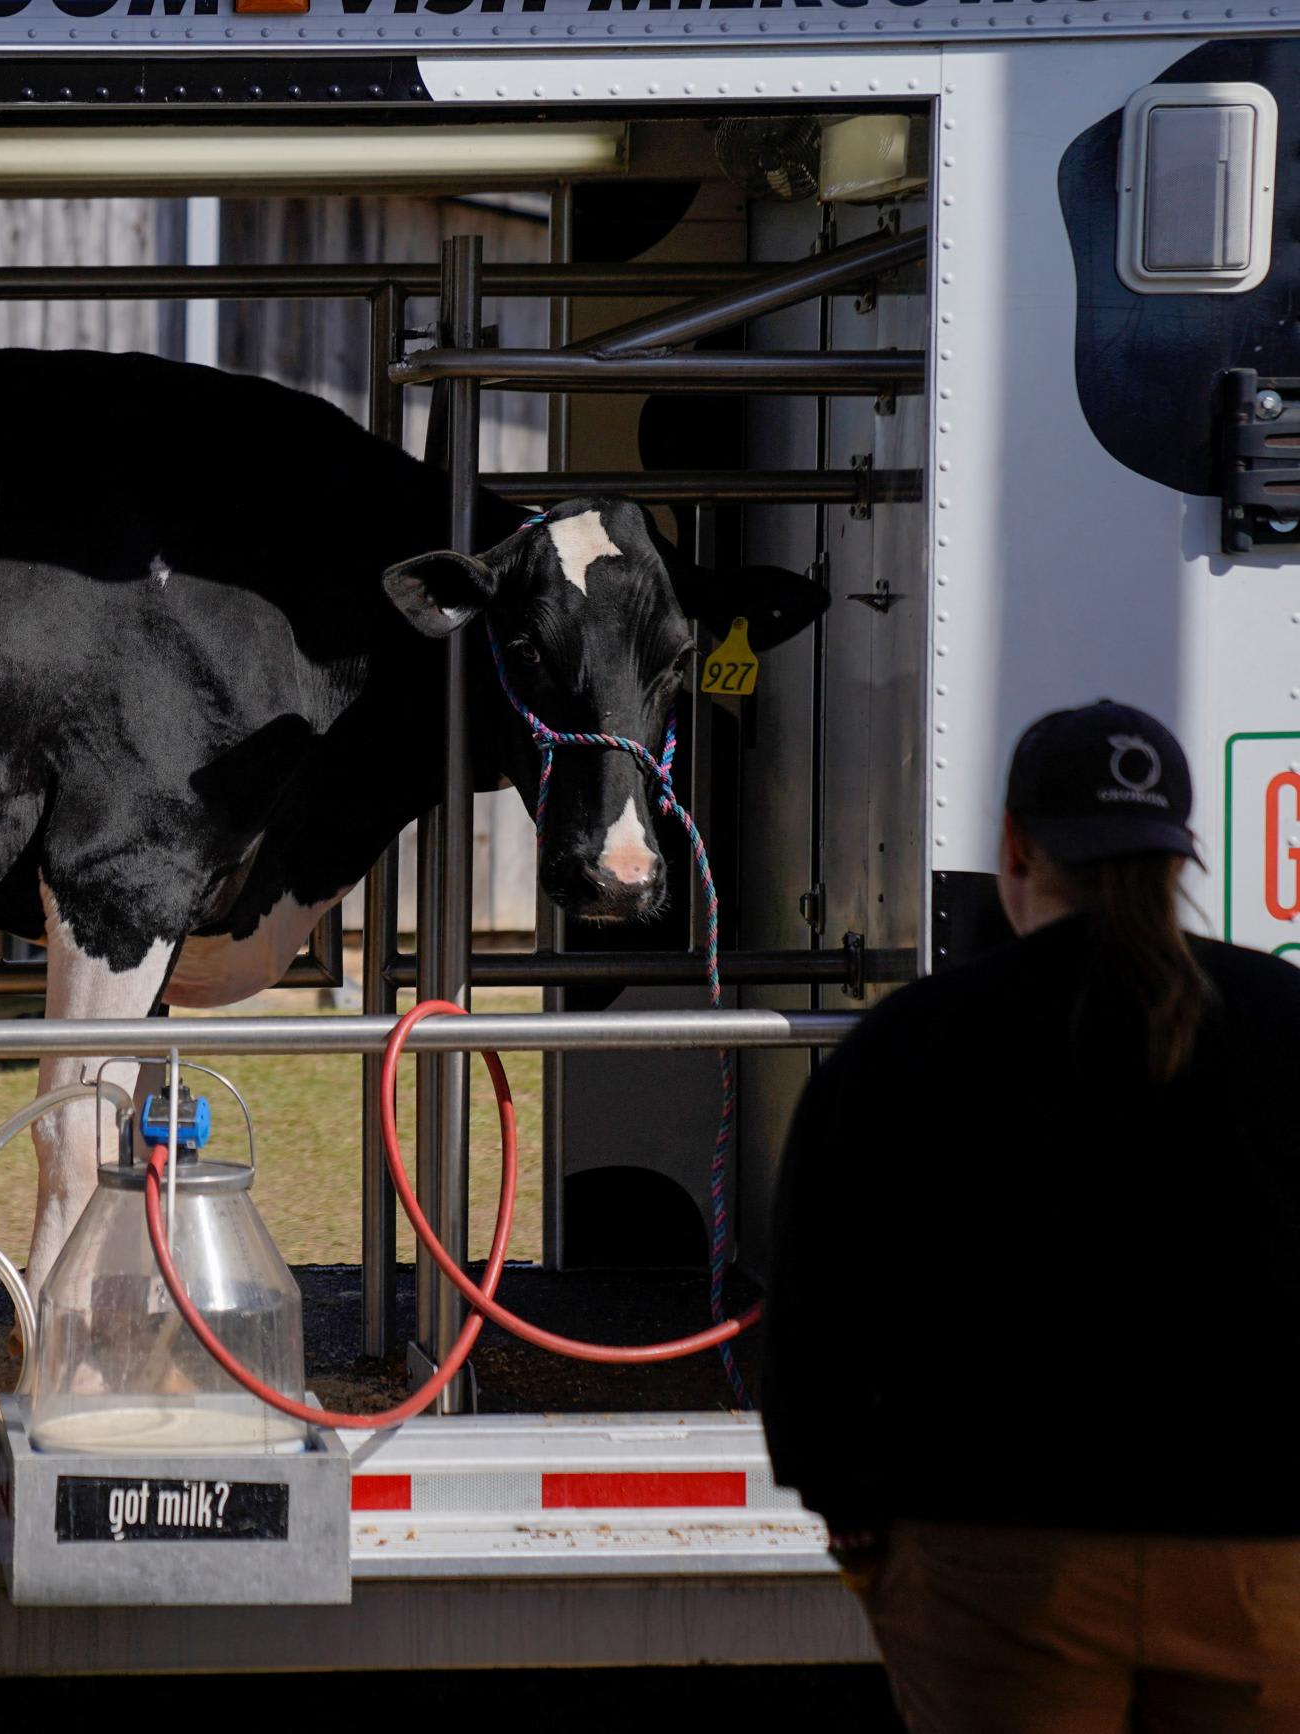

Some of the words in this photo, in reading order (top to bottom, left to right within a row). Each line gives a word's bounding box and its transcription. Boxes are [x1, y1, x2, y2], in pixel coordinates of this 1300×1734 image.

[706, 662, 755, 690] 927
[108, 1481, 150, 1541] got
[157, 1481, 231, 1529] milk?
